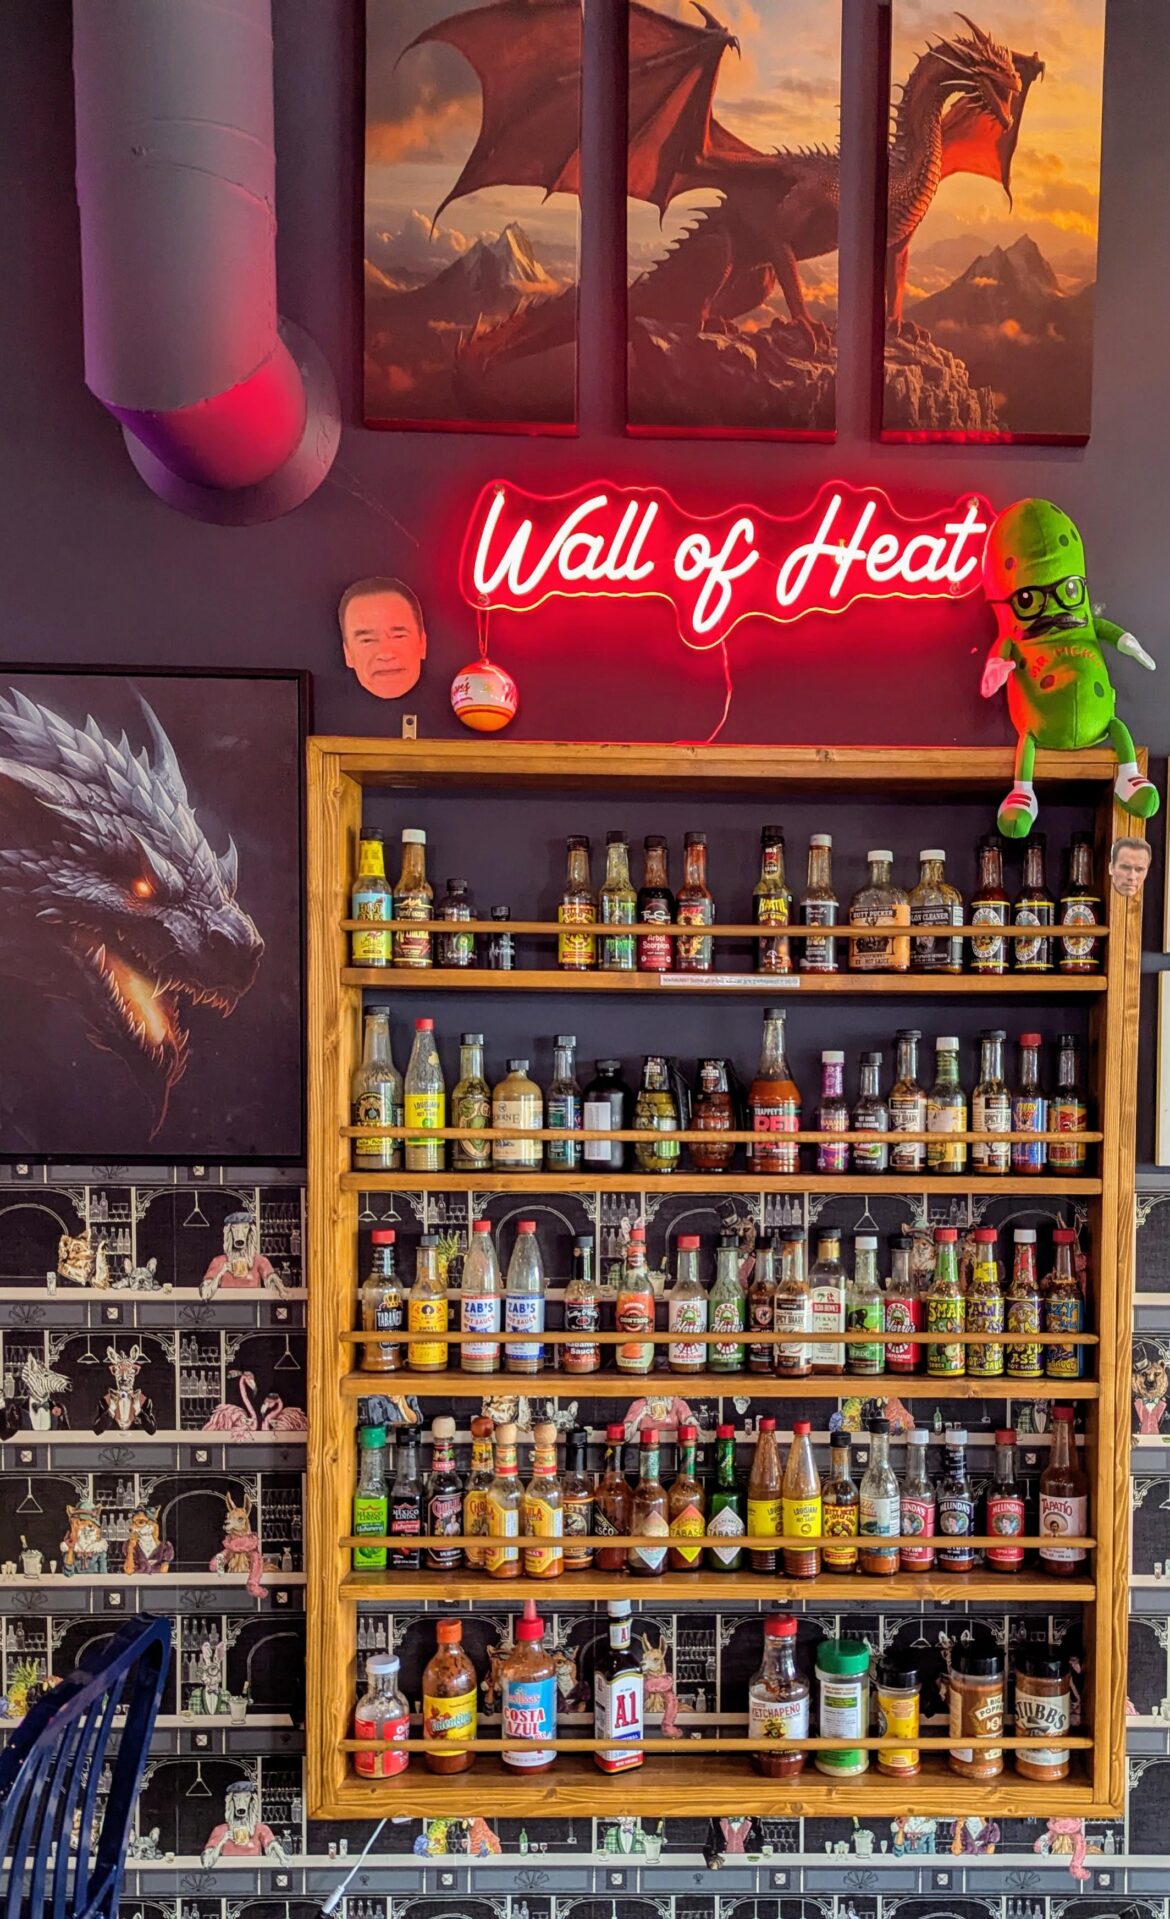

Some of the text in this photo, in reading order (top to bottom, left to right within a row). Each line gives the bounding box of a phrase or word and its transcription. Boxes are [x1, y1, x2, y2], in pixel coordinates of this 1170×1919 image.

[473, 490, 987, 633] Wall of Heat
[869, 909, 893, 917] PUCKER
[922, 912, 949, 921] CLEANER
[754, 1115, 799, 1132] RED
[464, 1302, 494, 1313] ZAB'S
[508, 1302, 536, 1313] ZAB'S
[570, 1347, 595, 1355] Sauce
[1010, 1353, 1037, 1364] ASS
[562, 1504, 588, 1514] ASTY
[901, 1502, 926, 1516] LINDA'S
[940, 1501, 970, 1514] MELINDA'S
[992, 1504, 1022, 1514] MELINDA'S
[1042, 1498, 1072, 1516] TAPATÍO
[503, 1707, 546, 1723] COSTA
[614, 1690, 639, 1729] A1
[751, 1702, 800, 1719] KETCHAPEÑO
[507, 1721, 539, 1736] AZUL
